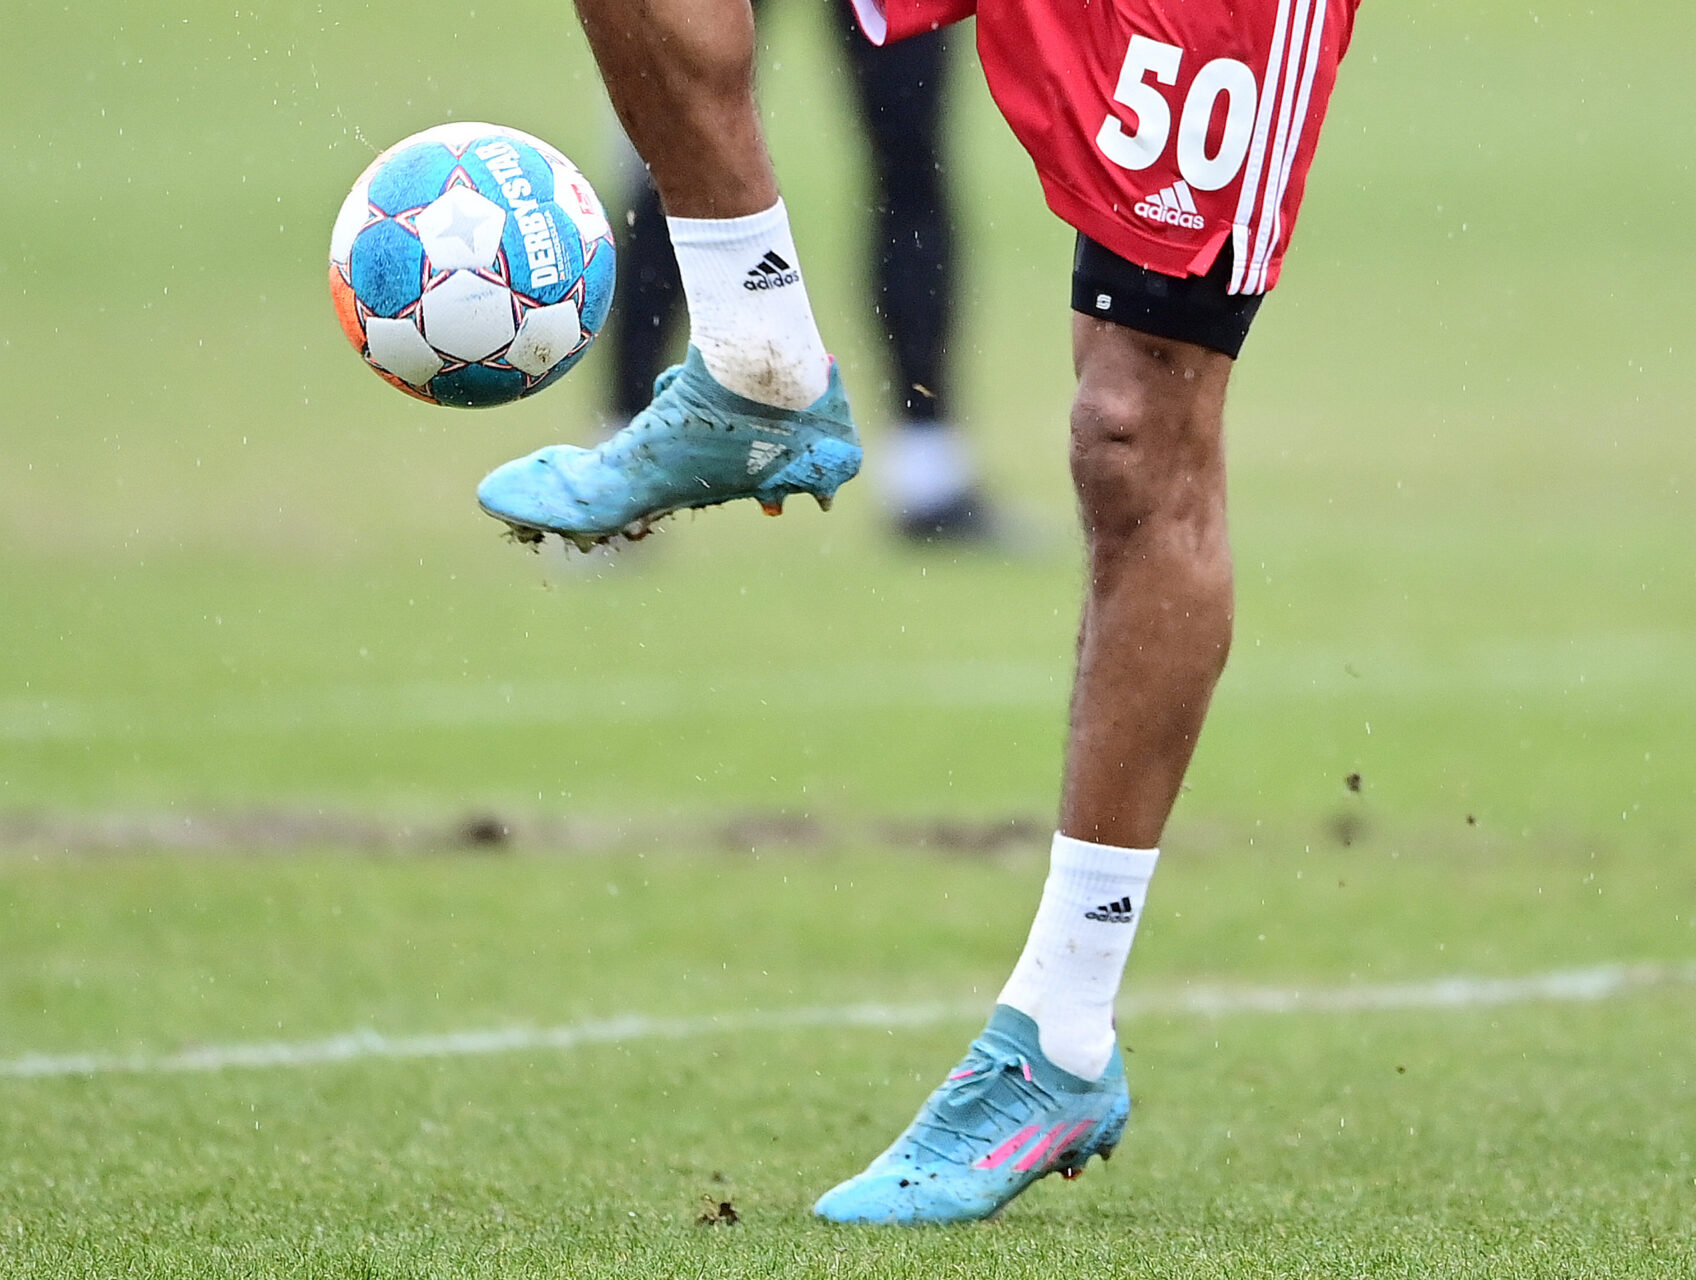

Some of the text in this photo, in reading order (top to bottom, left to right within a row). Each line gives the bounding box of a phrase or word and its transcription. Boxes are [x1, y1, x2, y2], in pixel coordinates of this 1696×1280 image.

[1095, 33, 1258, 191] 50
[475, 141, 558, 289] DERBYSTAR
[544, 210, 565, 271] BUNDESLIGA
[1134, 201, 1205, 229] adidas
[743, 270, 800, 291] adidas
